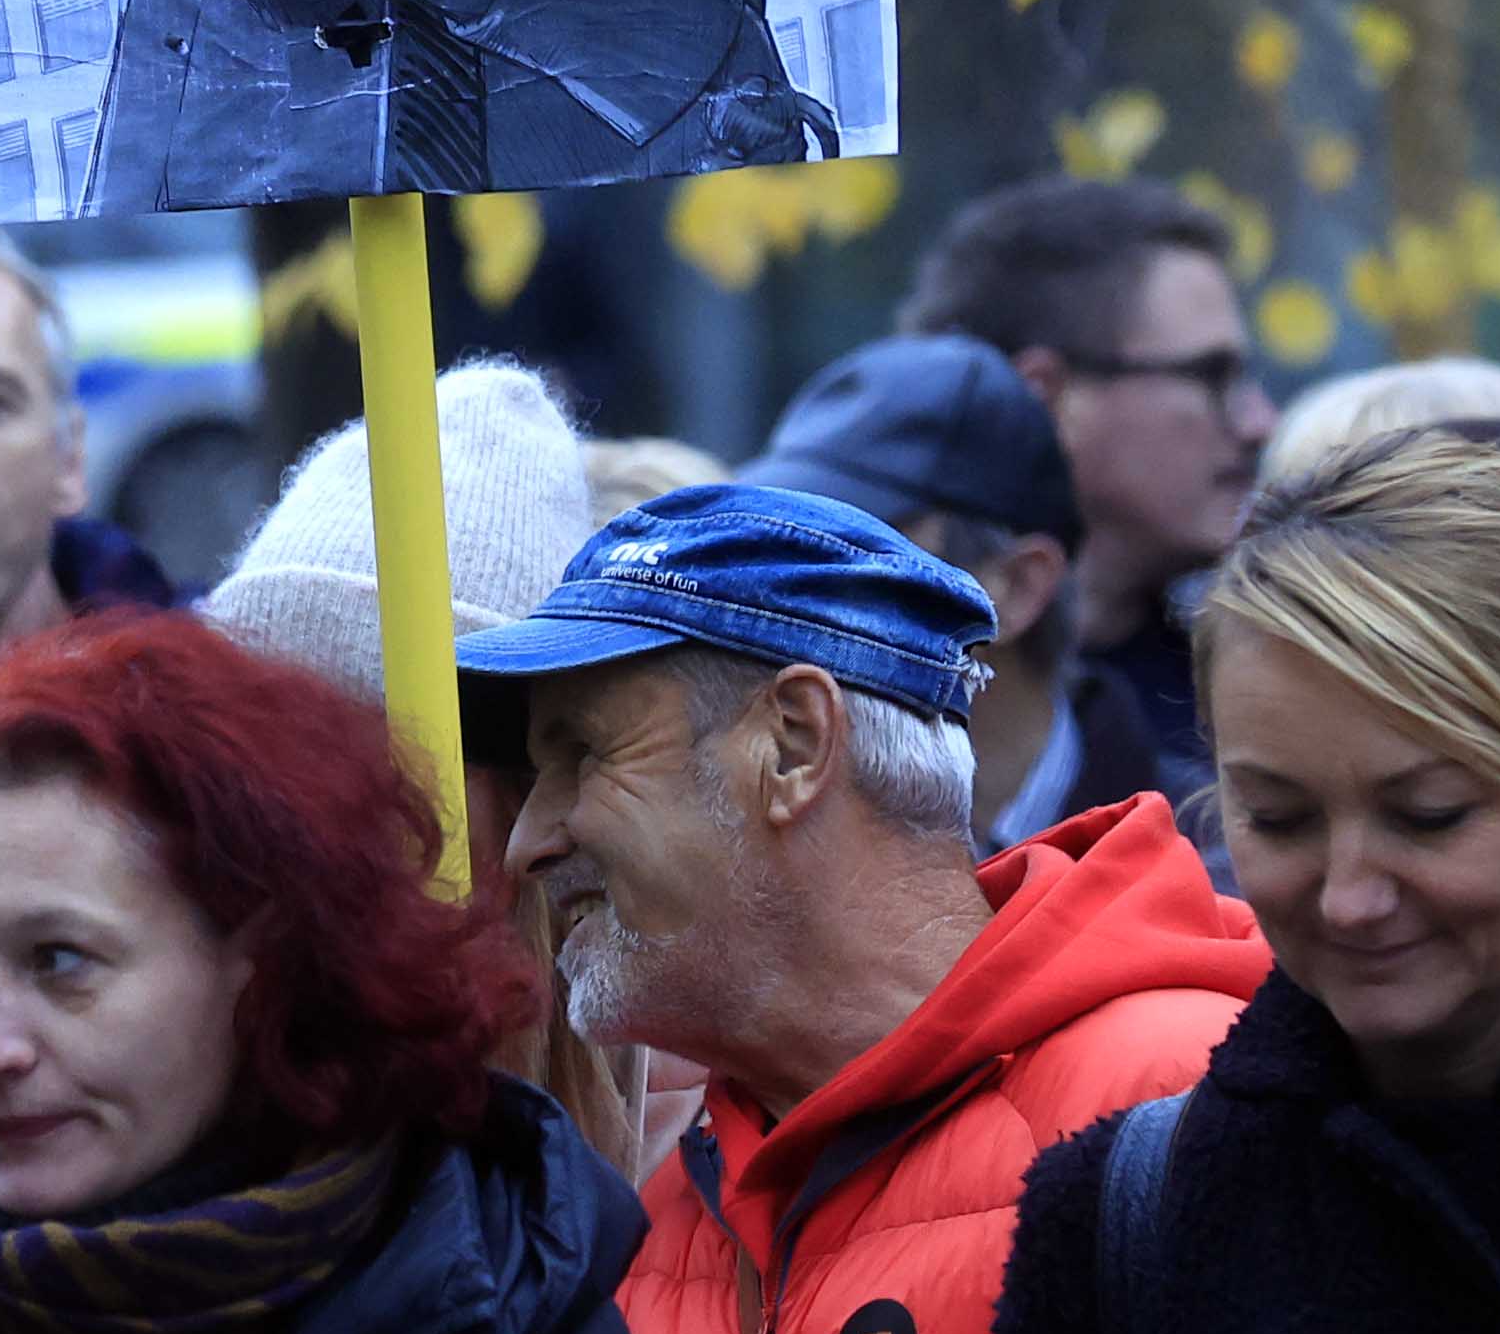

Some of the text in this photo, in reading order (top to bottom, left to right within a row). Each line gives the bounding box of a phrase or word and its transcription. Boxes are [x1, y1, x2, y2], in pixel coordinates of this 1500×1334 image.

[600, 564, 698, 593] universe of fun
